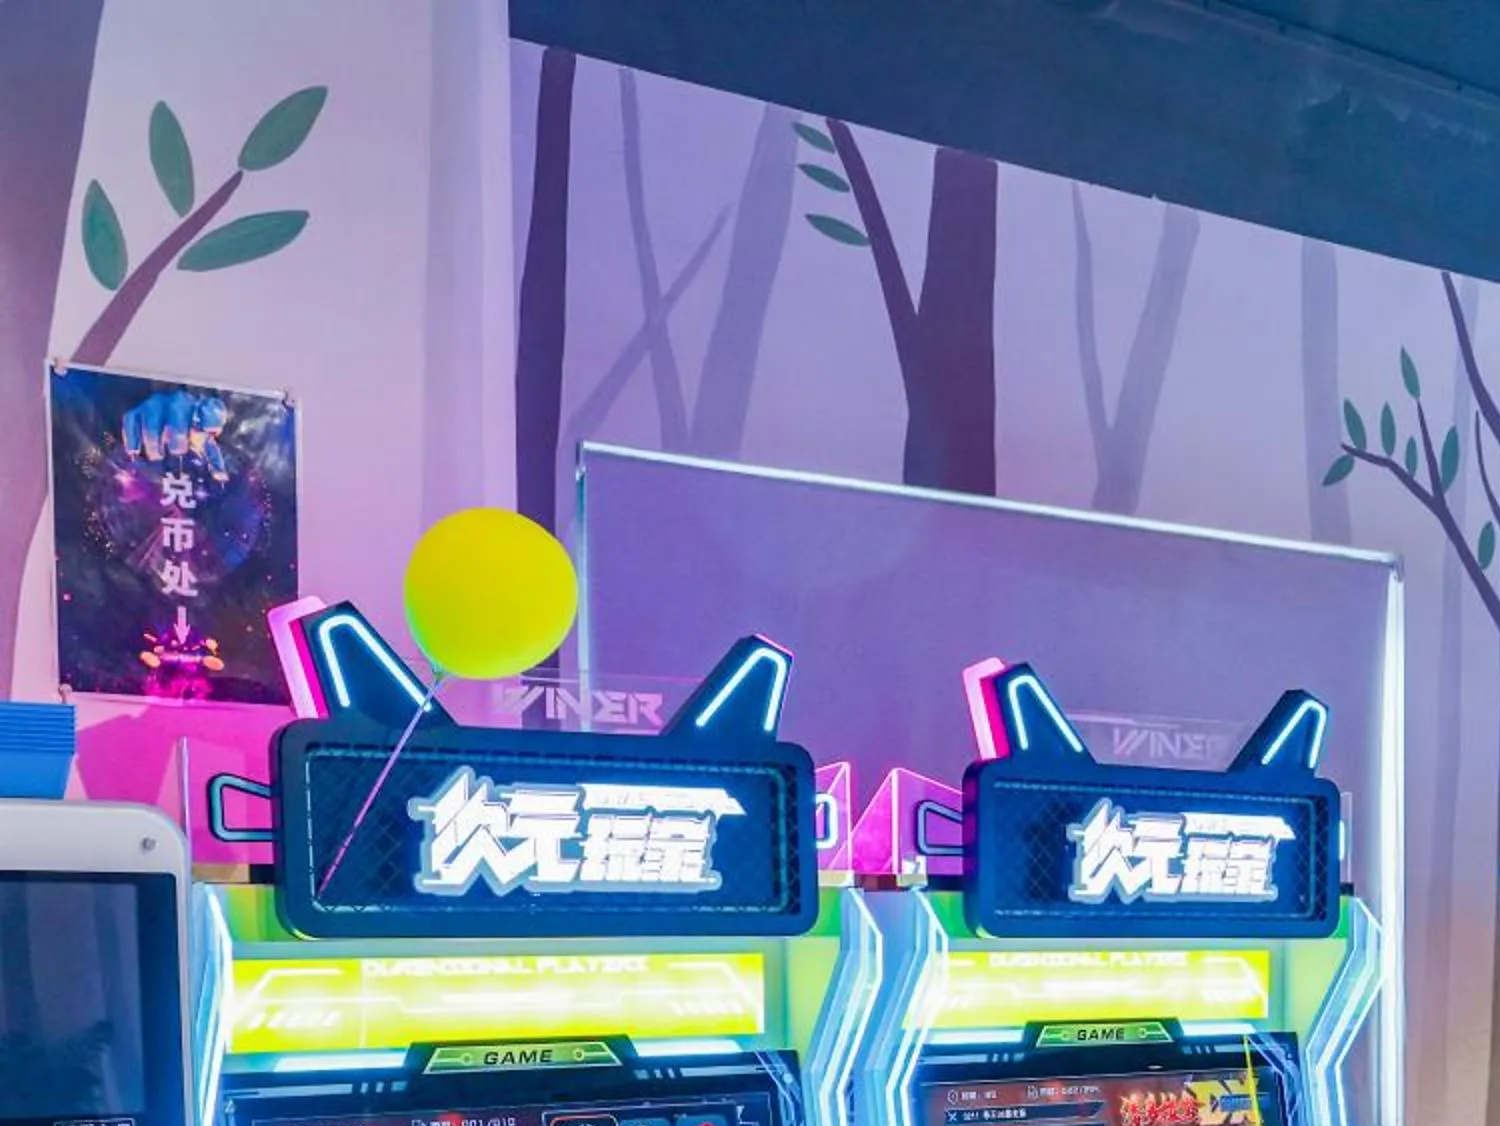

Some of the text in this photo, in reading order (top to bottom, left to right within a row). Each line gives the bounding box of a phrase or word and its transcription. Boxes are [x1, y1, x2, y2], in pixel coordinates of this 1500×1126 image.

[159, 471, 199, 597] 兑币处
[1077, 1027, 1125, 1041] GAME
[484, 1049, 553, 1065] GAME
